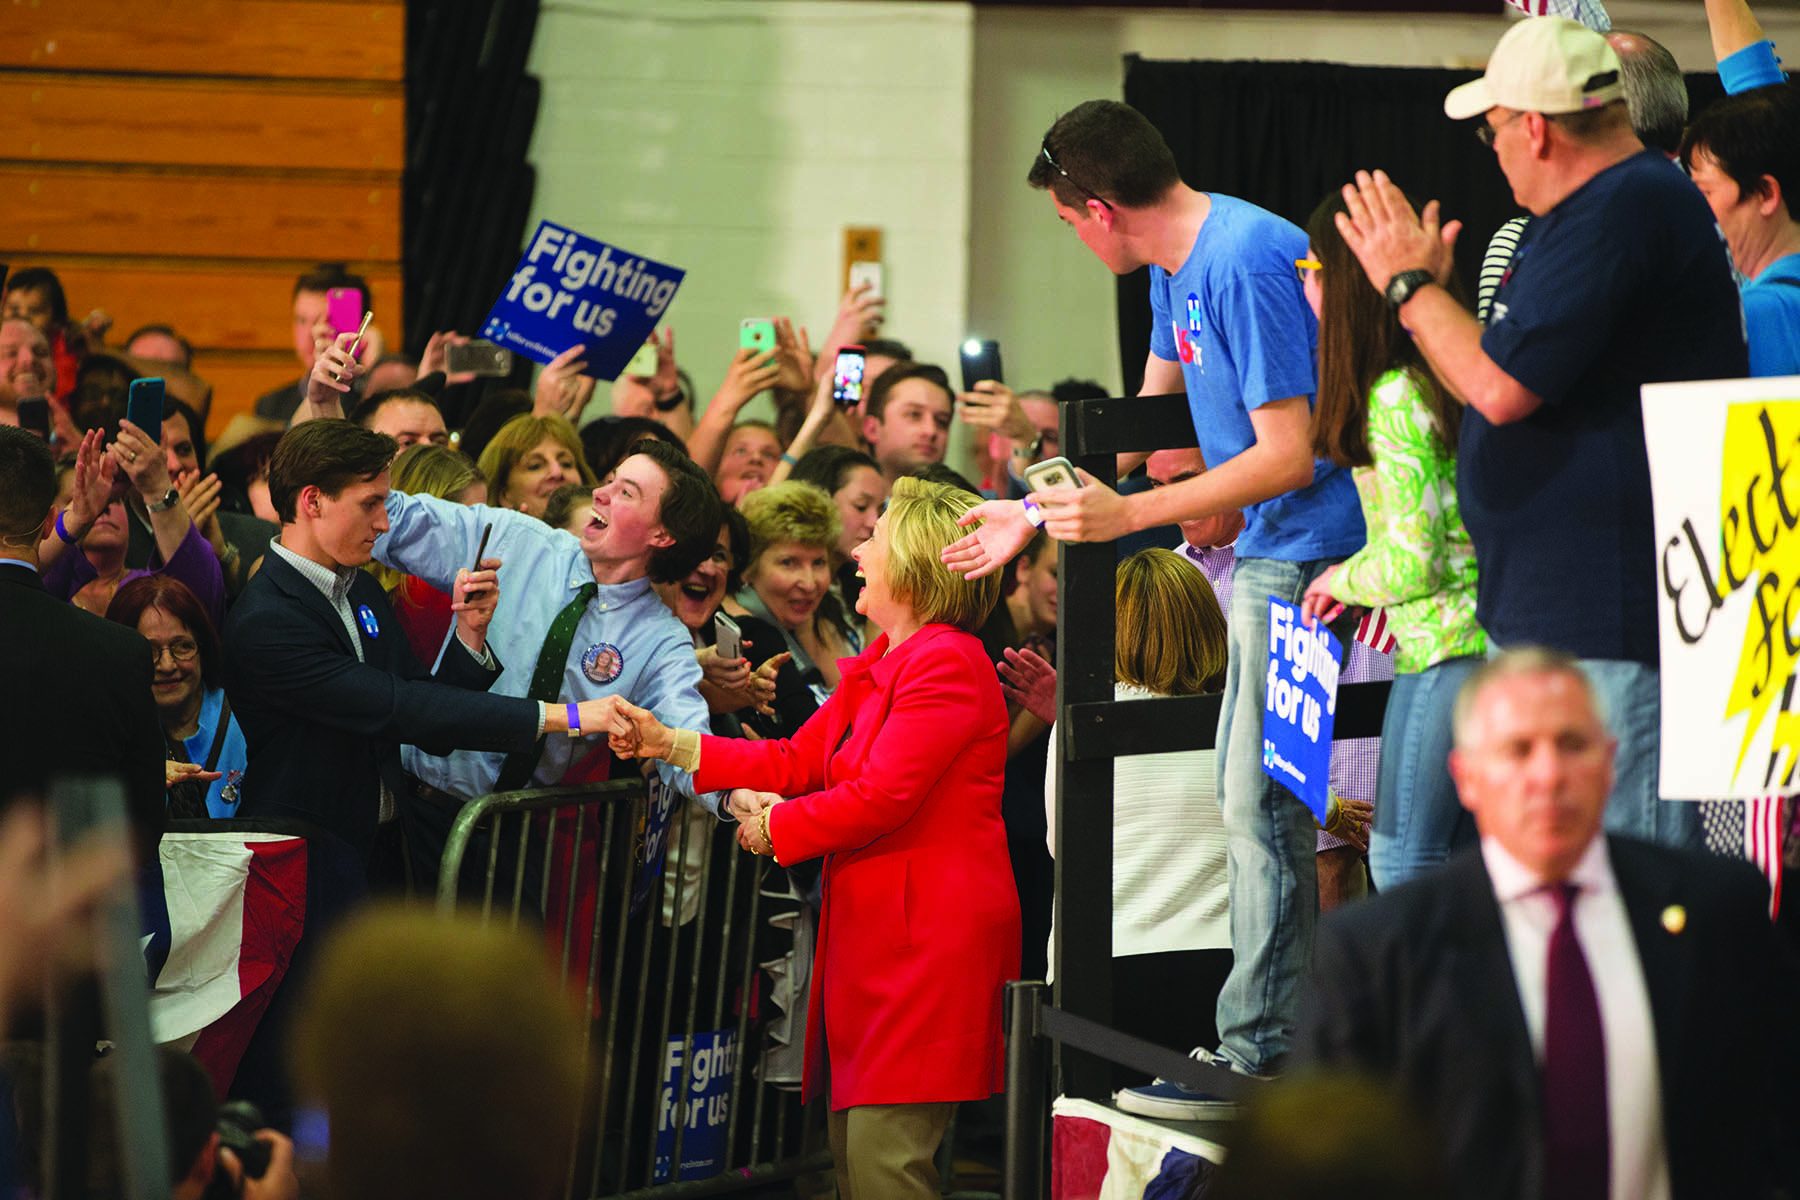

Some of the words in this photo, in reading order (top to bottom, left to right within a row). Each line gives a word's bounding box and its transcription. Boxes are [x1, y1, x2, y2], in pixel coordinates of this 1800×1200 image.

[506, 265, 574, 320] for
[572, 299, 618, 337] us
[528, 225, 677, 317] Fighting
[1663, 408, 1800, 645] Elect
[1270, 602, 1340, 716] Fighting
[1752, 571, 1800, 699] fo
[1266, 658, 1304, 725] for
[1302, 693, 1322, 743] us
[648, 776, 674, 823] Fig
[658, 1086, 705, 1132] for
[707, 1091, 729, 1127] us
